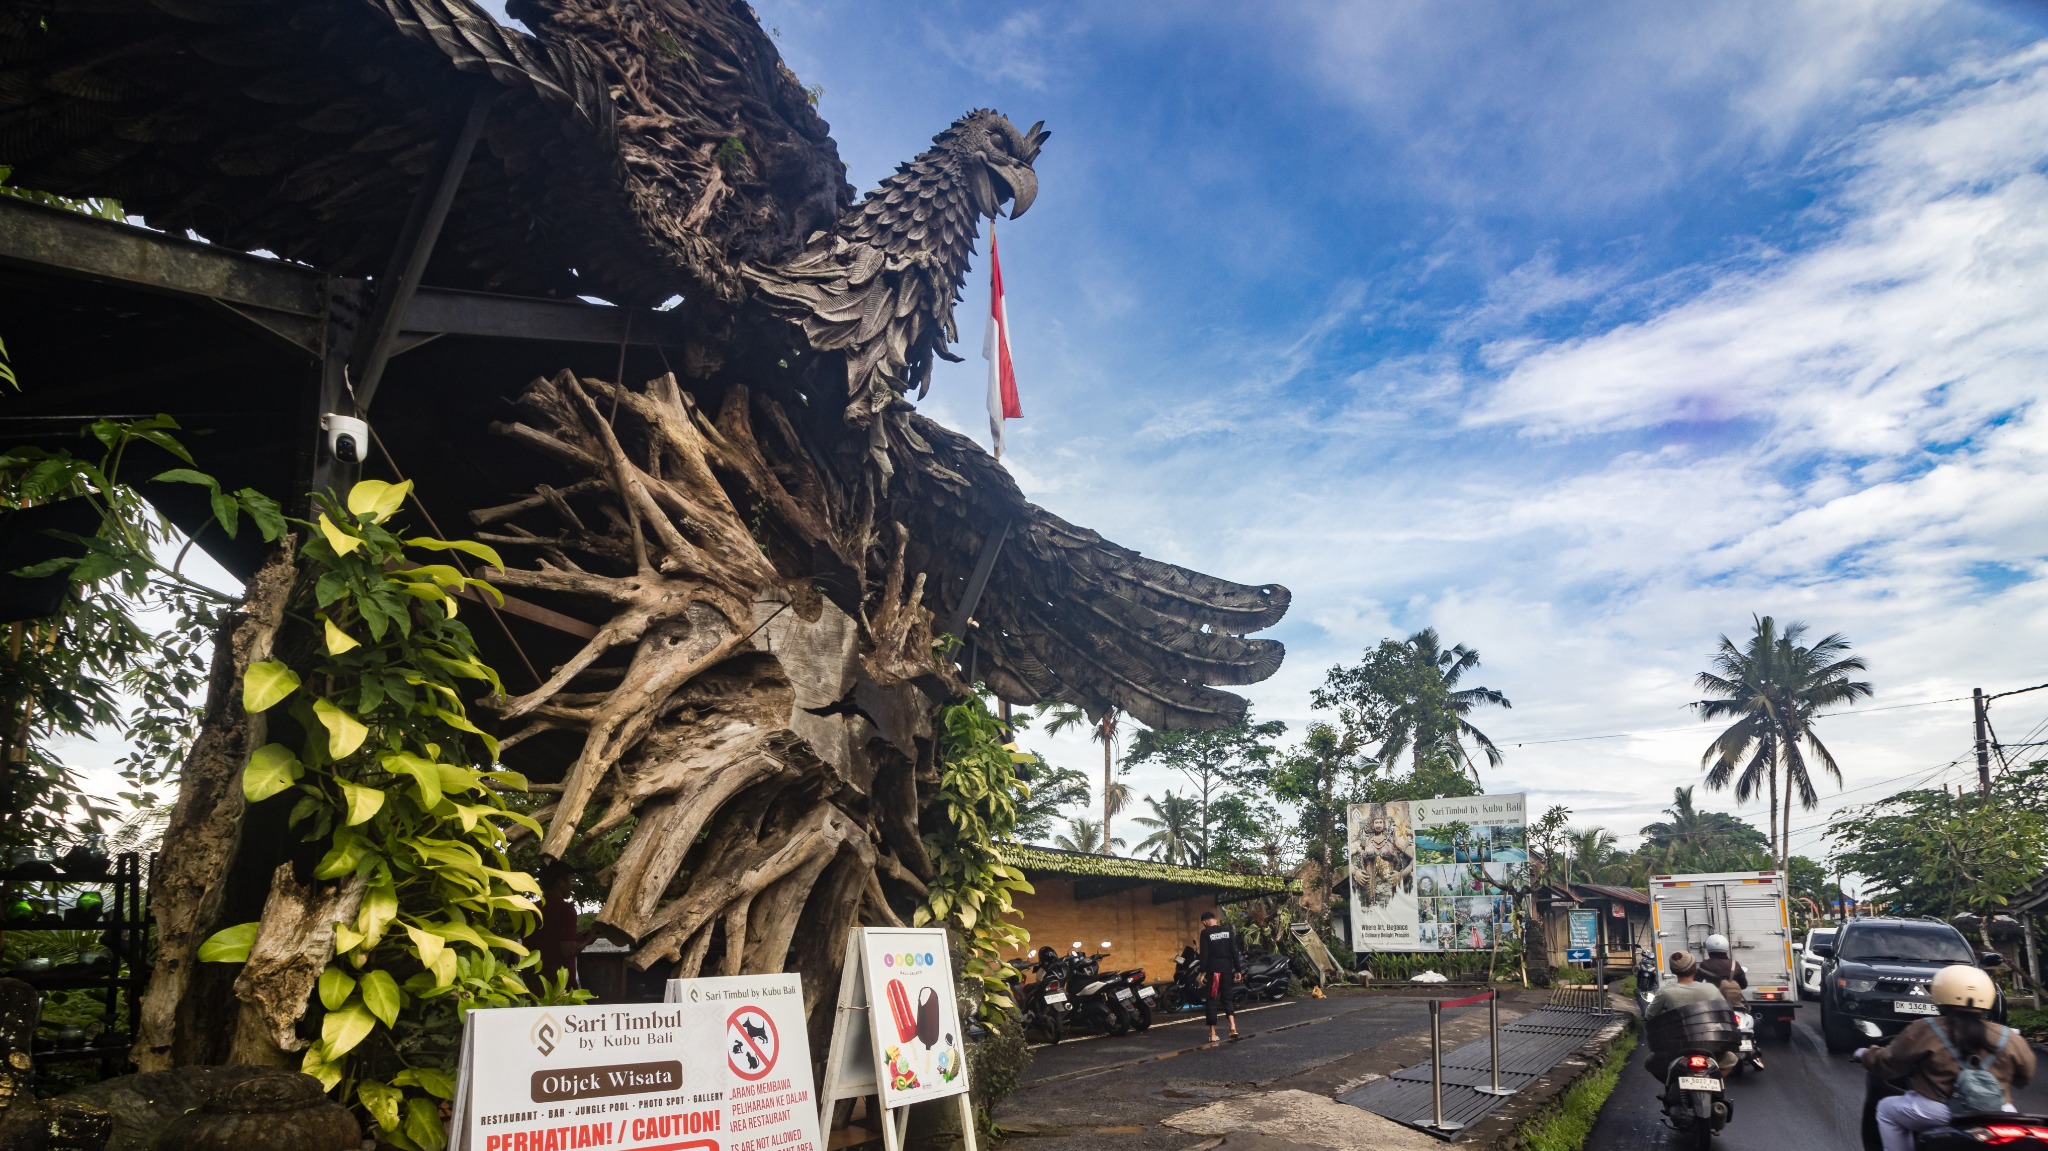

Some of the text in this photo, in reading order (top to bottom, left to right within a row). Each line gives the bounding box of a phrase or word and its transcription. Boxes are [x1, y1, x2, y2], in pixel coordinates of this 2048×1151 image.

[1431, 802, 1522, 815] Sari Timbul by Kubu Bali
[705, 985, 796, 1001] Sari Timbul by Kubu Bali
[564, 1009, 683, 1034] Sari Timbul
[579, 1032, 674, 1051] by Kubu Bali
[542, 1069, 673, 1097] Objek Wisata
[757, 1078, 791, 1095] MEMBAWA
[480, 1091, 724, 1126] RESTAURANT BAR JUNGLE POOL PHOTO SPOT GALLERY
[732, 1091, 808, 1116] PELIHARAAN KE DALAM
[486, 1109, 721, 1151] PERHATIAN! / CAUTION!
[748, 1109, 790, 1129] RESTAURANT
[741, 1140, 755, 1151] ARE
[756, 1136, 770, 1150] NOT
[772, 1129, 802, 1146] ALLOWED
